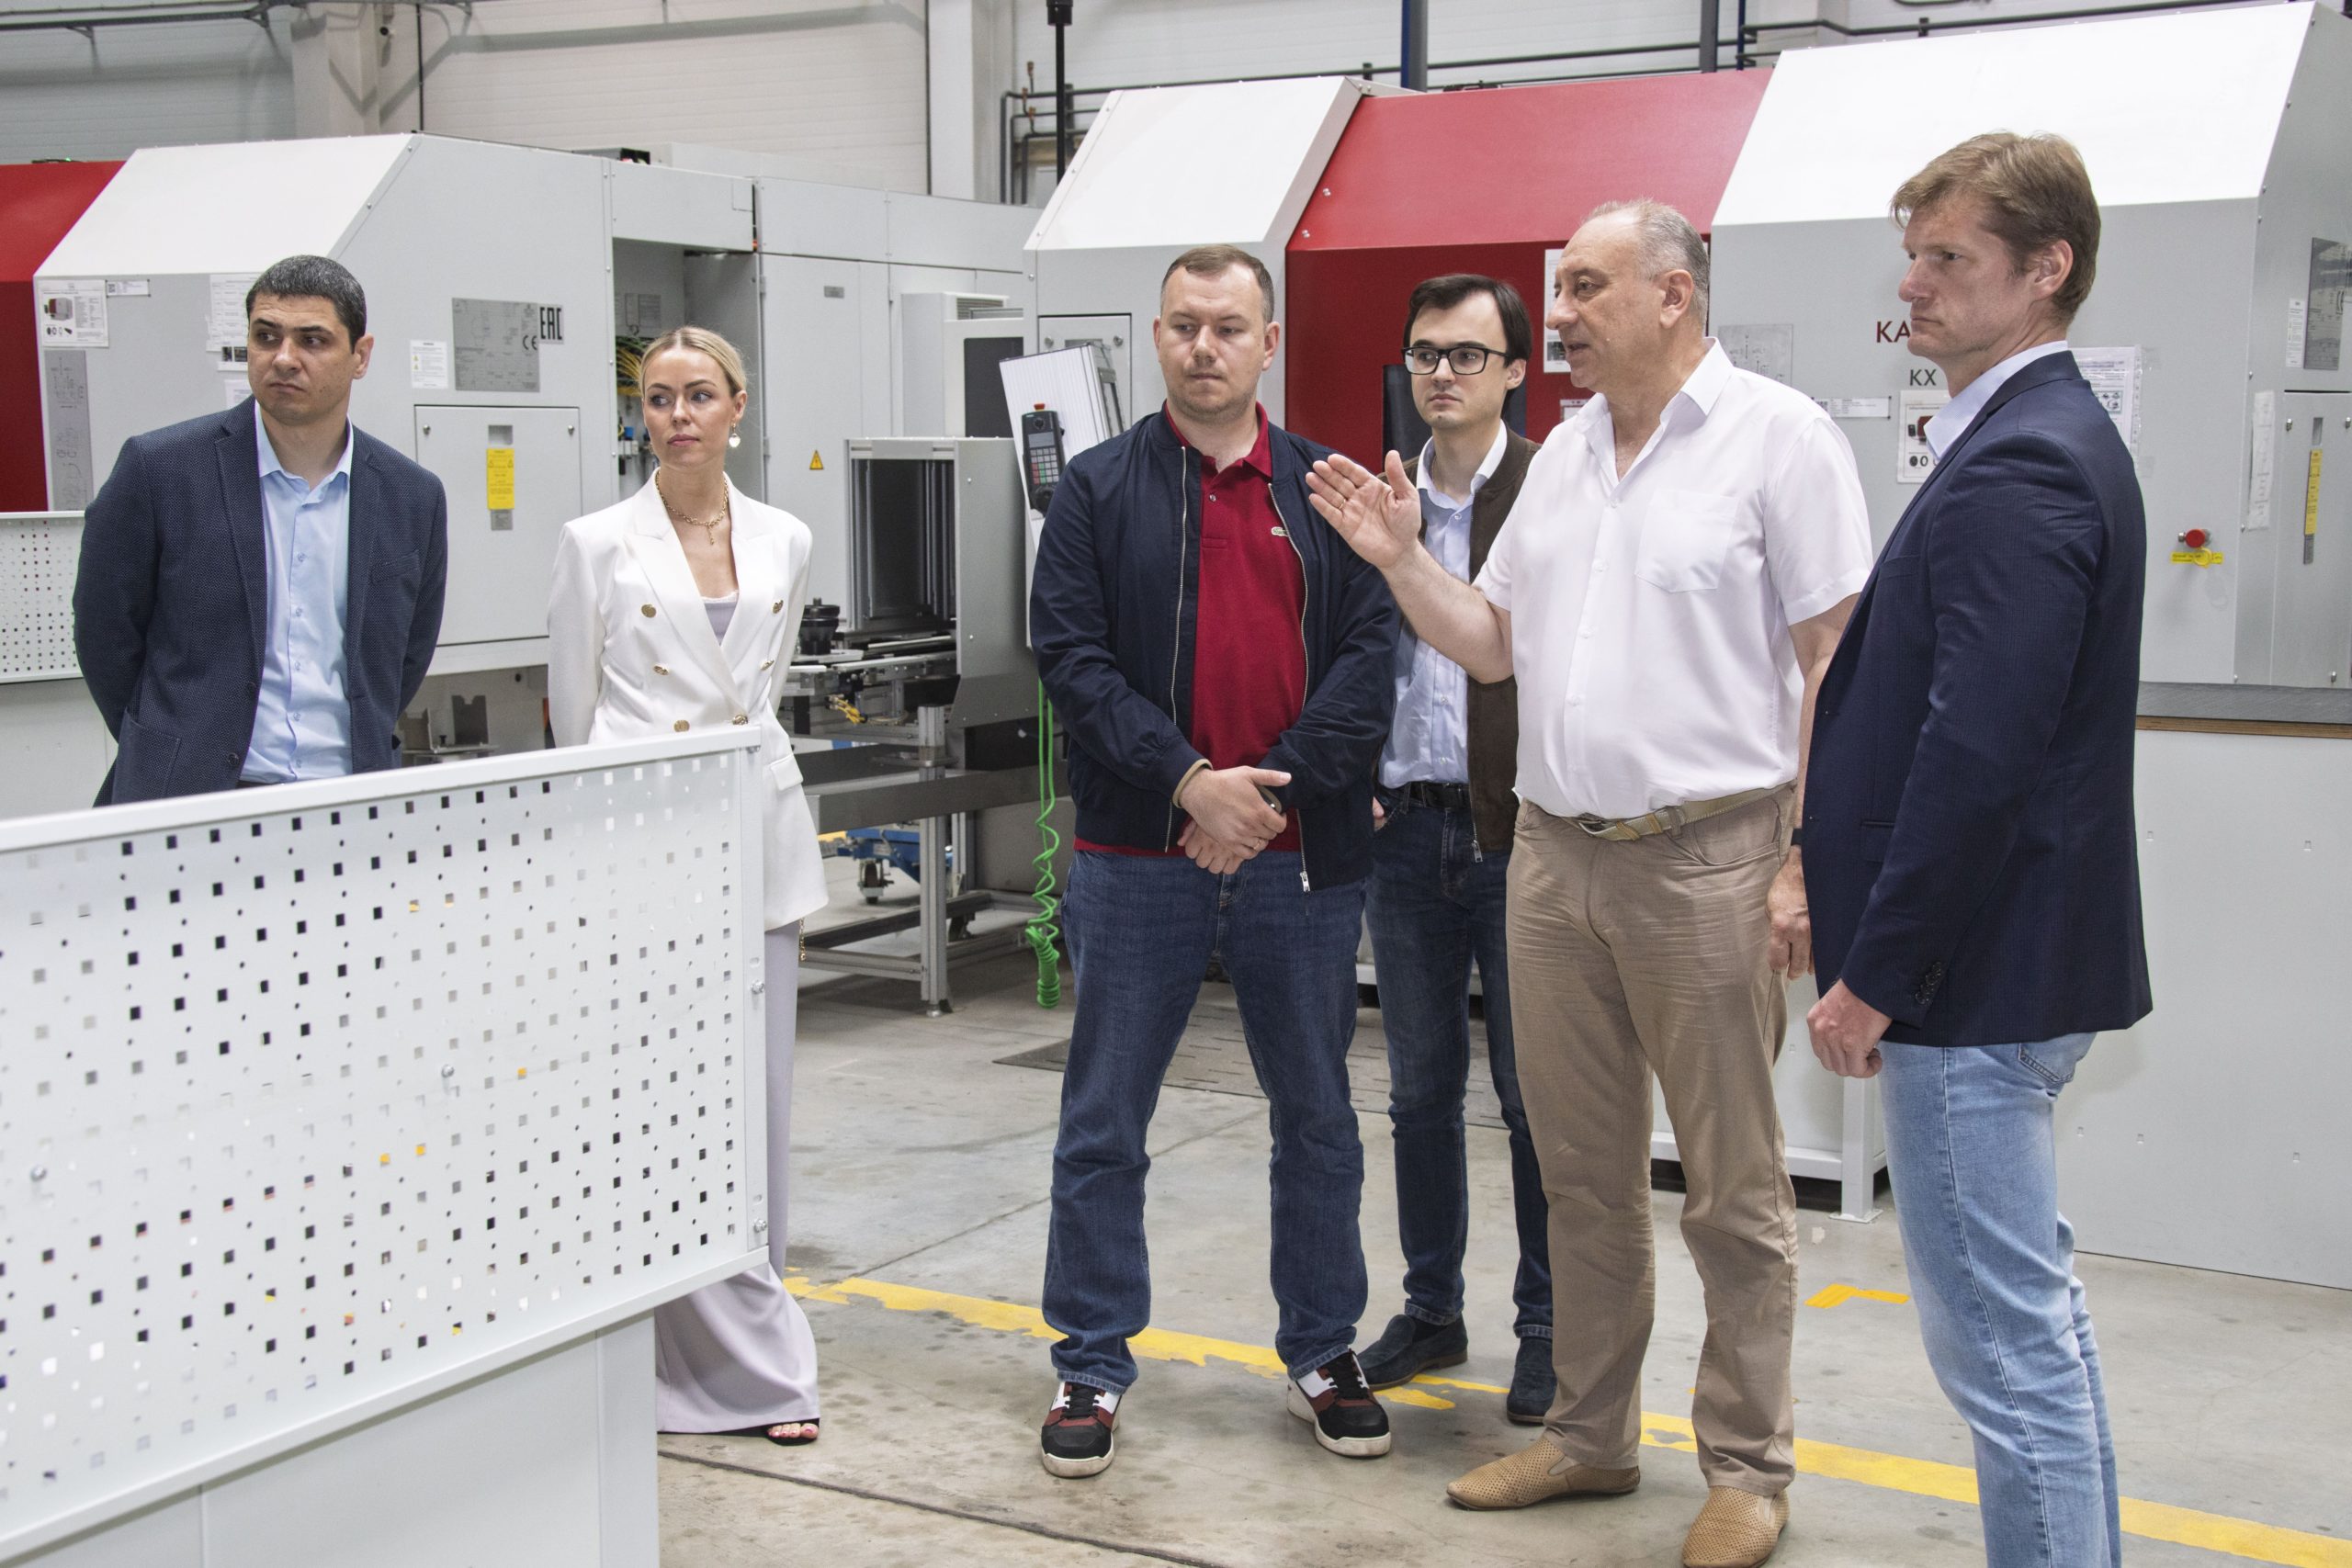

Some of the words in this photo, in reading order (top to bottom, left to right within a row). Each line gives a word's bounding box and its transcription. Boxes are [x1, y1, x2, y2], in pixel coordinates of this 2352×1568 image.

[539, 307, 563, 341] EAC
[523, 334, 537, 351] CE
[1909, 369, 1937, 387] KX
